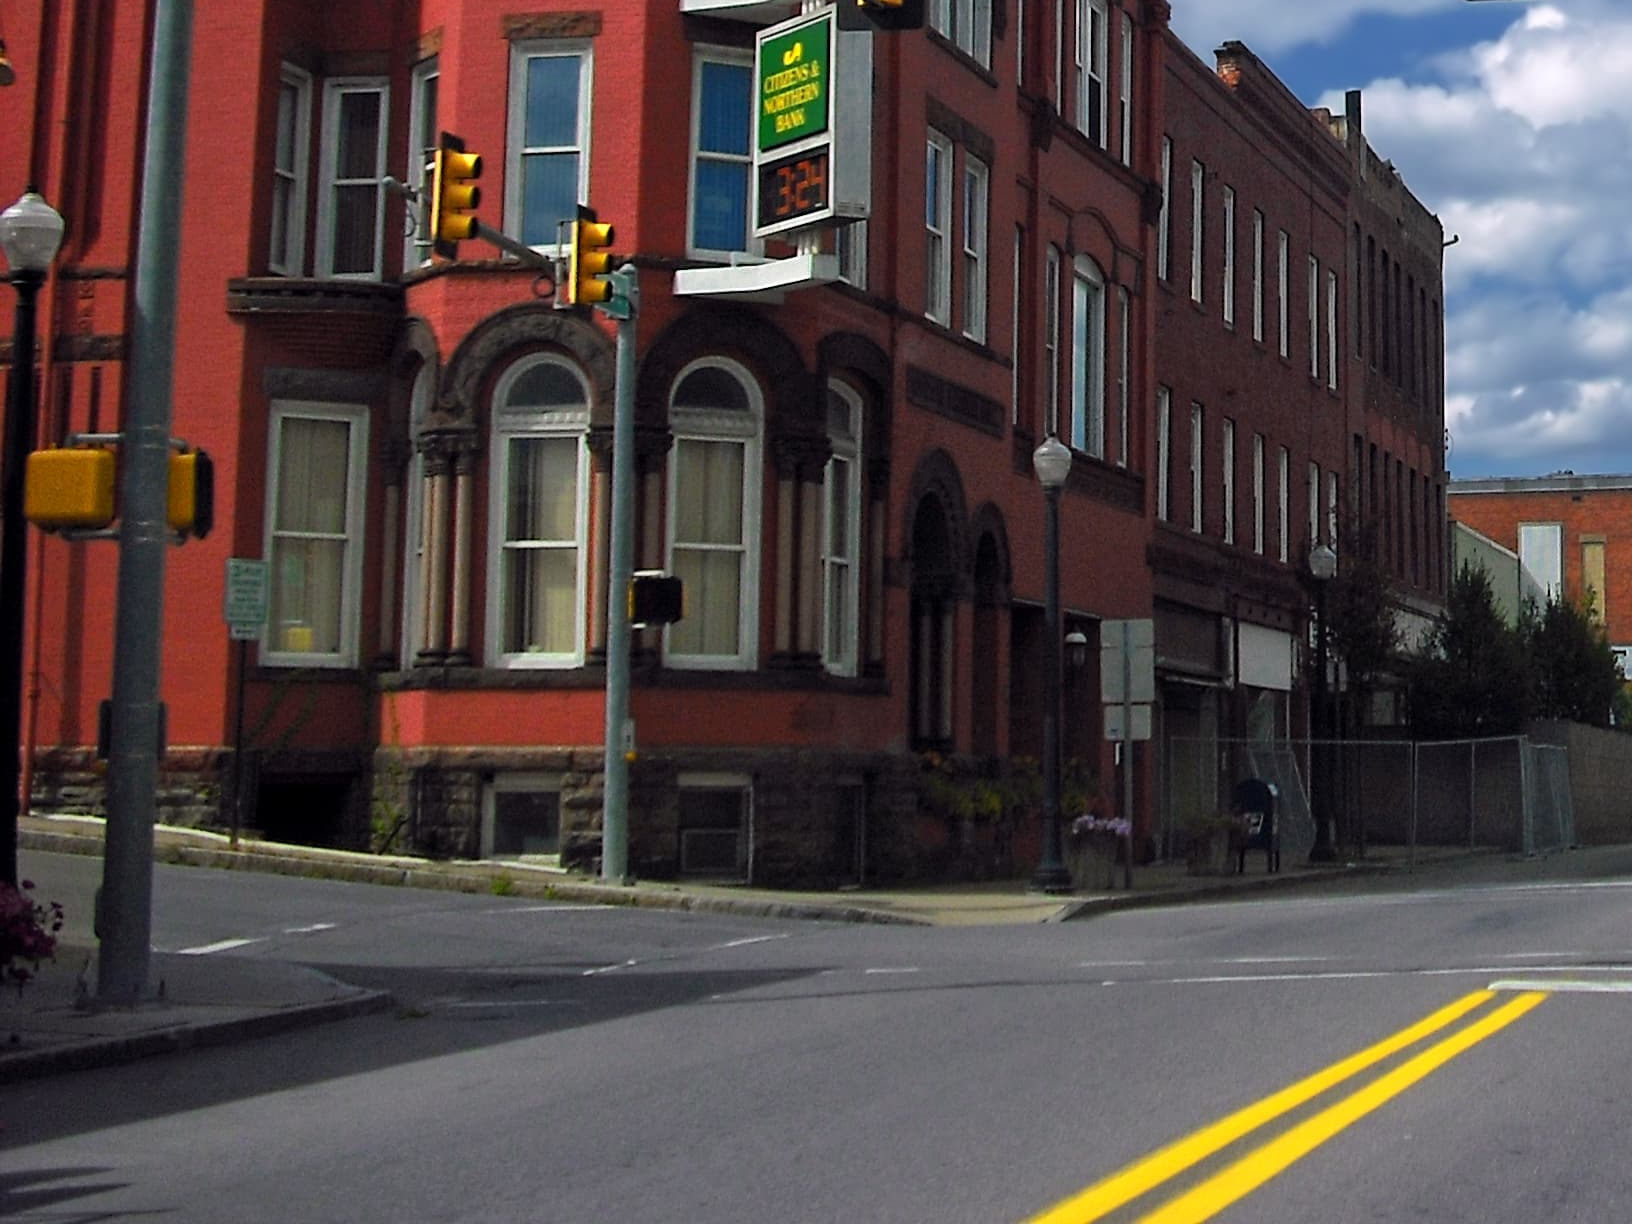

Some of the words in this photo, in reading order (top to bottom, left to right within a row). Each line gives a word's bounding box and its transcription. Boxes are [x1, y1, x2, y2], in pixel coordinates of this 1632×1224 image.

[764, 63, 810, 95] CITIZENS
[811, 59, 821, 78] &
[763, 81, 820, 114] NORTHERN
[776, 107, 806, 133] BANK
